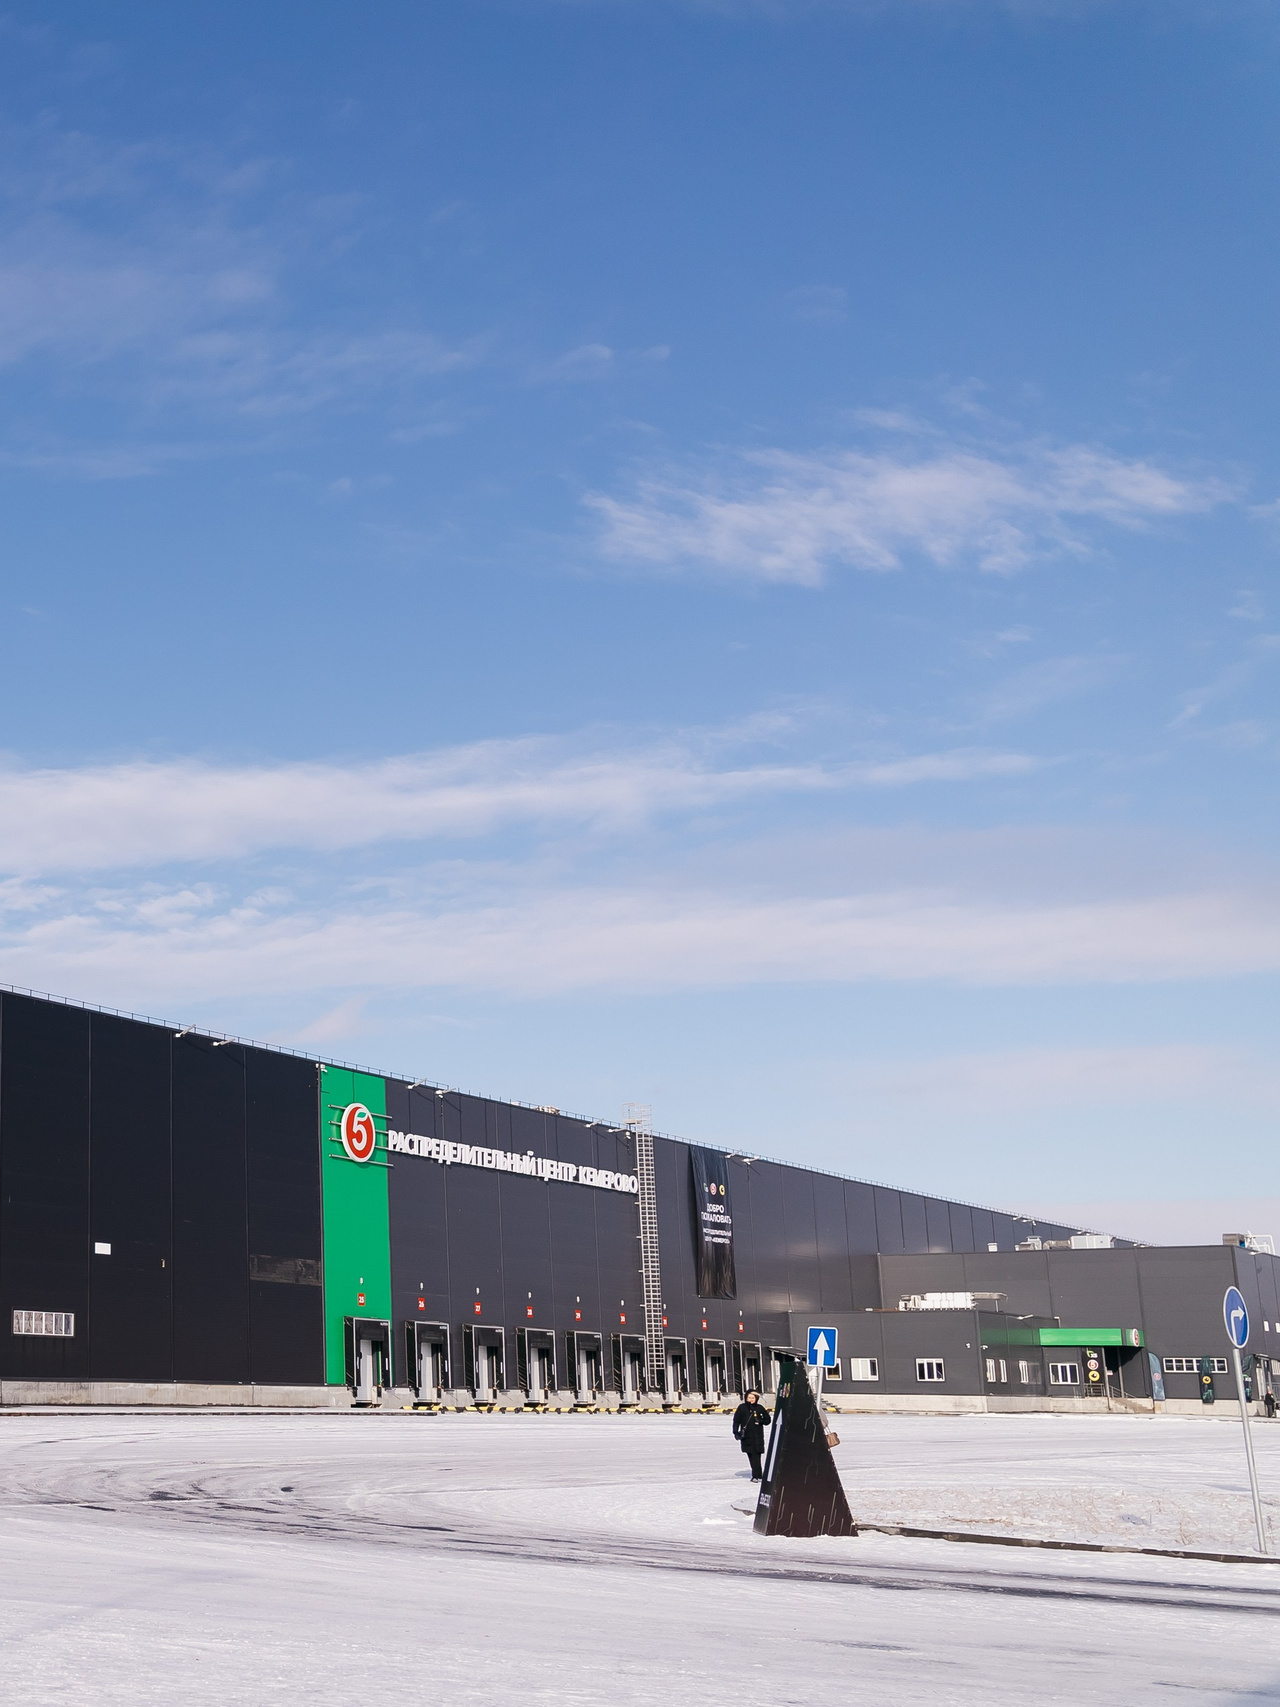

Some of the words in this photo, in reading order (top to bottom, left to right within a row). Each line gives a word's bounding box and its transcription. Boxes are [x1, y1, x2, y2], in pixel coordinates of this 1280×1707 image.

[388, 1129, 536, 1176] РАСПРЕДЕЛИТЕЛЬНЫЙ
[536, 1157, 577, 1182] ЦЕНТР
[578, 1165, 638, 1194] КЕМЕРОВО
[358, 1296, 365, 1304] 25
